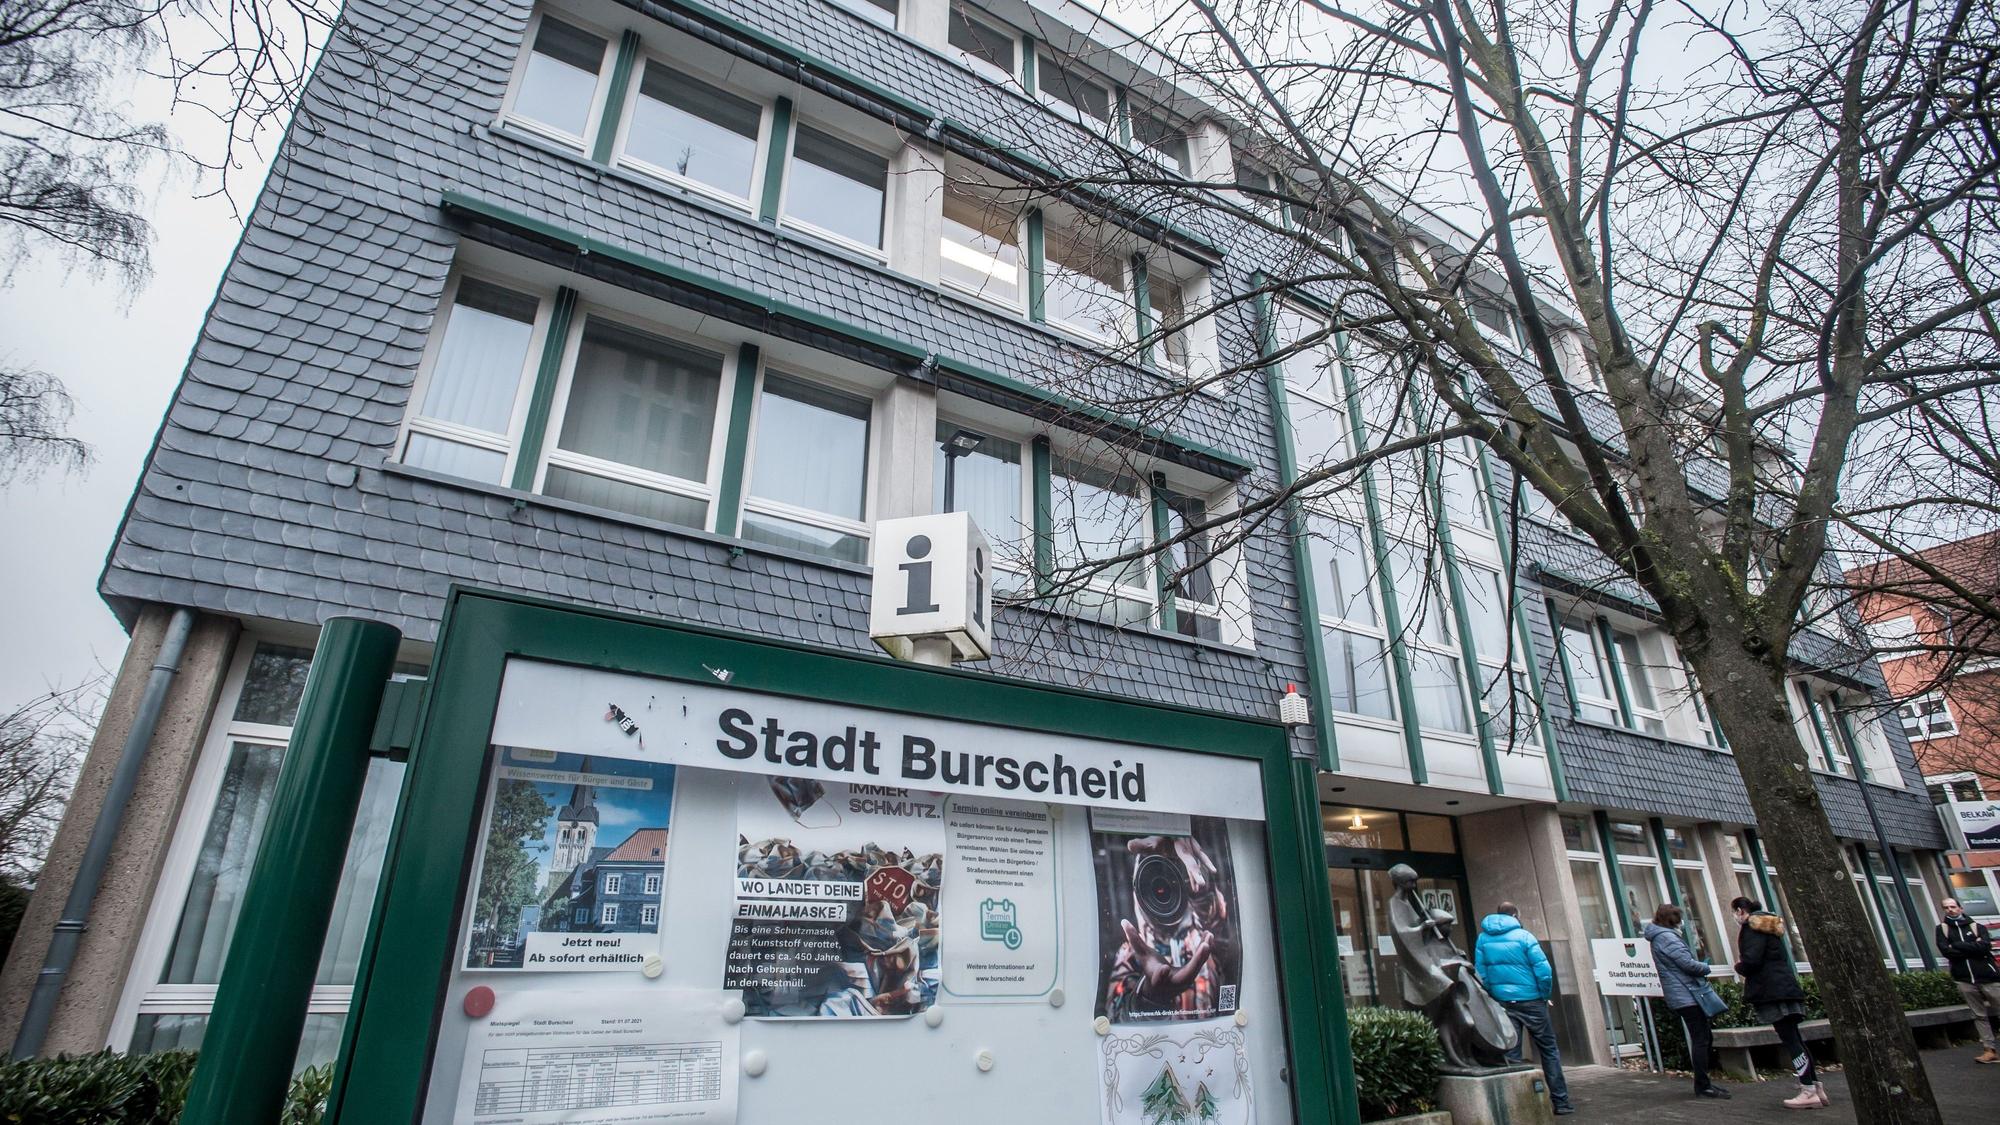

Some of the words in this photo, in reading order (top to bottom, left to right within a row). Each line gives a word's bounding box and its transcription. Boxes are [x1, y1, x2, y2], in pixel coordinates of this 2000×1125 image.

[896, 534, 940, 616] i
[716, 707, 881, 776] Stadt
[901, 734, 1147, 803] Burscheid
[507, 767, 566, 782] Wissenswertes
[568, 774, 581, 782] für
[582, 774, 609, 787] Bürger
[610, 777, 625, 787] und
[626, 778, 648, 788] Gäste
[848, 783, 909, 798] IMMER
[849, 798, 941, 819] SCHMUTZ.
[952, 803, 979, 813] Termin
[980, 807, 1003, 816] online
[1004, 809, 1047, 820] vereinbaren
[956, 832, 994, 841] Bürgerservice
[741, 881, 764, 894] WO
[768, 882, 820, 896] LANDET
[824, 884, 860, 898] DEINE
[738, 904, 844, 920] EINMALMASKE?
[986, 912, 1011, 921] Termin
[734, 925, 749, 934] Bis
[751, 926, 772, 934] eine
[774, 926, 835, 936] Schutzmaske
[562, 938, 592, 947] Jetzt
[596, 938, 621, 948] neu!
[751, 938, 802, 948] Kunststoff
[802, 940, 842, 950] verottet,
[528, 953, 546, 963] Ab
[549, 953, 585, 963] sofort
[588, 954, 644, 963] erhältlich
[729, 951, 762, 960] dauert
[794, 952, 812, 961] 450
[814, 953, 843, 962] Jahre.
[728, 965, 754, 974] Nach
[756, 965, 802, 974] Gebrauch
[726, 978, 737, 987] in
[739, 978, 758, 987] den
[760, 978, 806, 988] Restmüll.
